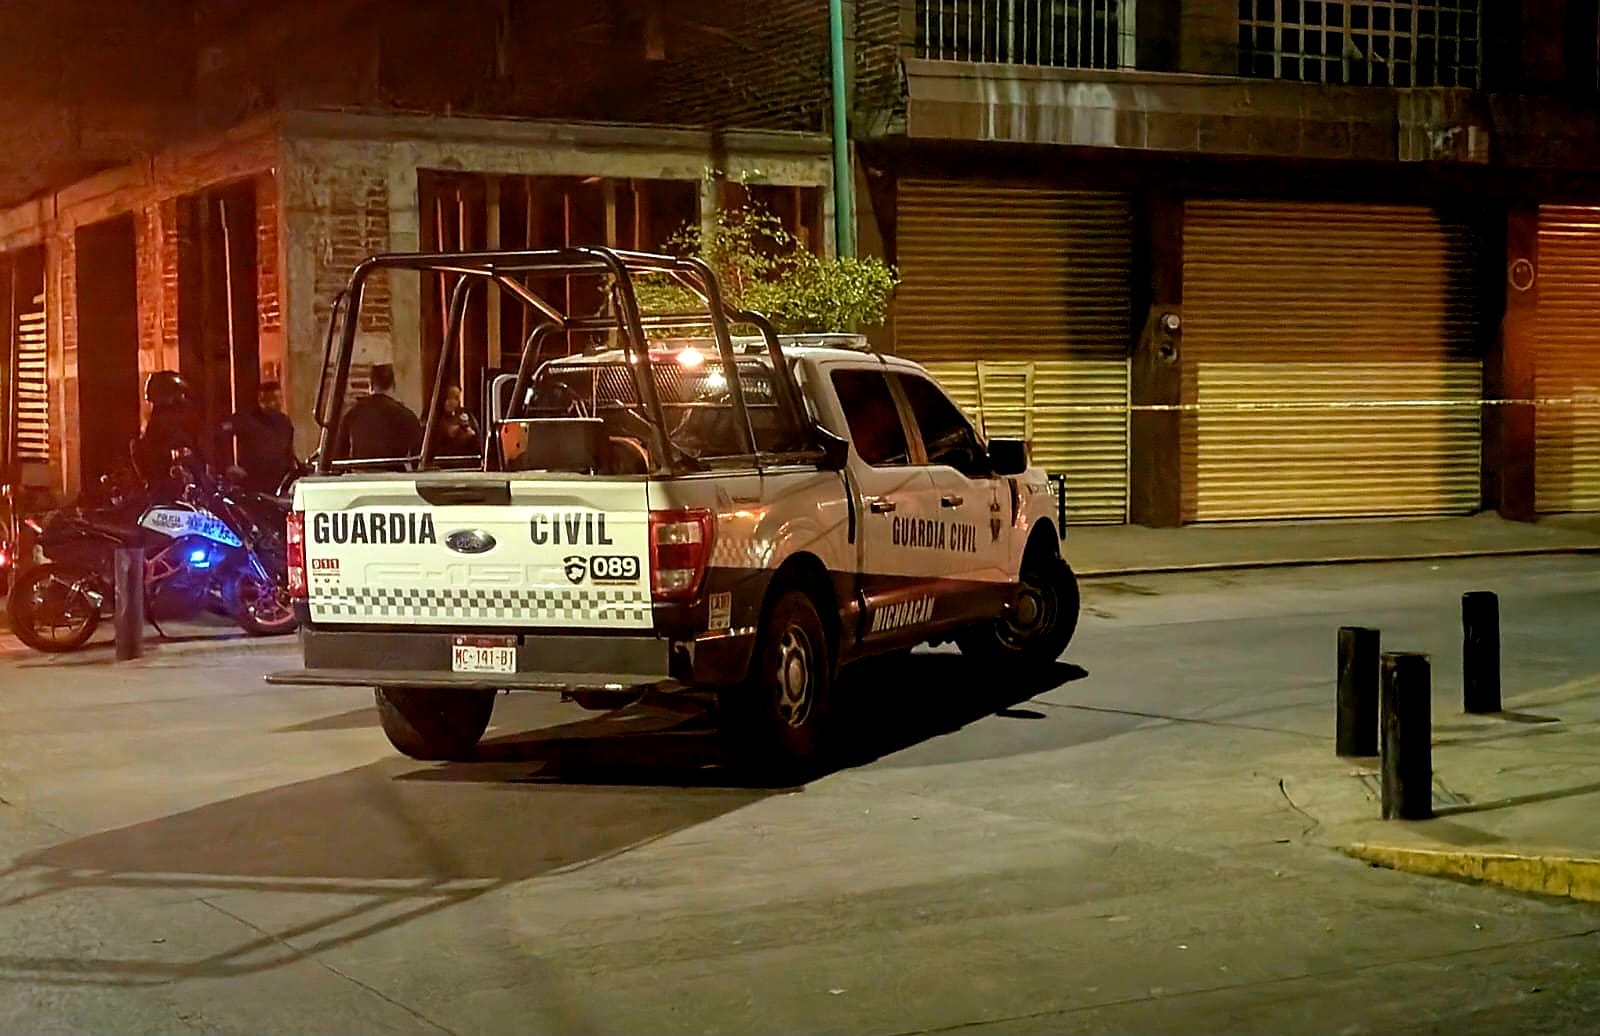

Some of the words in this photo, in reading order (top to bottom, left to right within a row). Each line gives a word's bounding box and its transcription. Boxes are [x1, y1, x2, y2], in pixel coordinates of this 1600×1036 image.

[313, 511, 437, 545] GUARDIA
[530, 512, 614, 546] CIVIL
[892, 515, 946, 550] GUARDIA
[949, 522, 977, 553] CIVIL
[593, 557, 637, 577] 089
